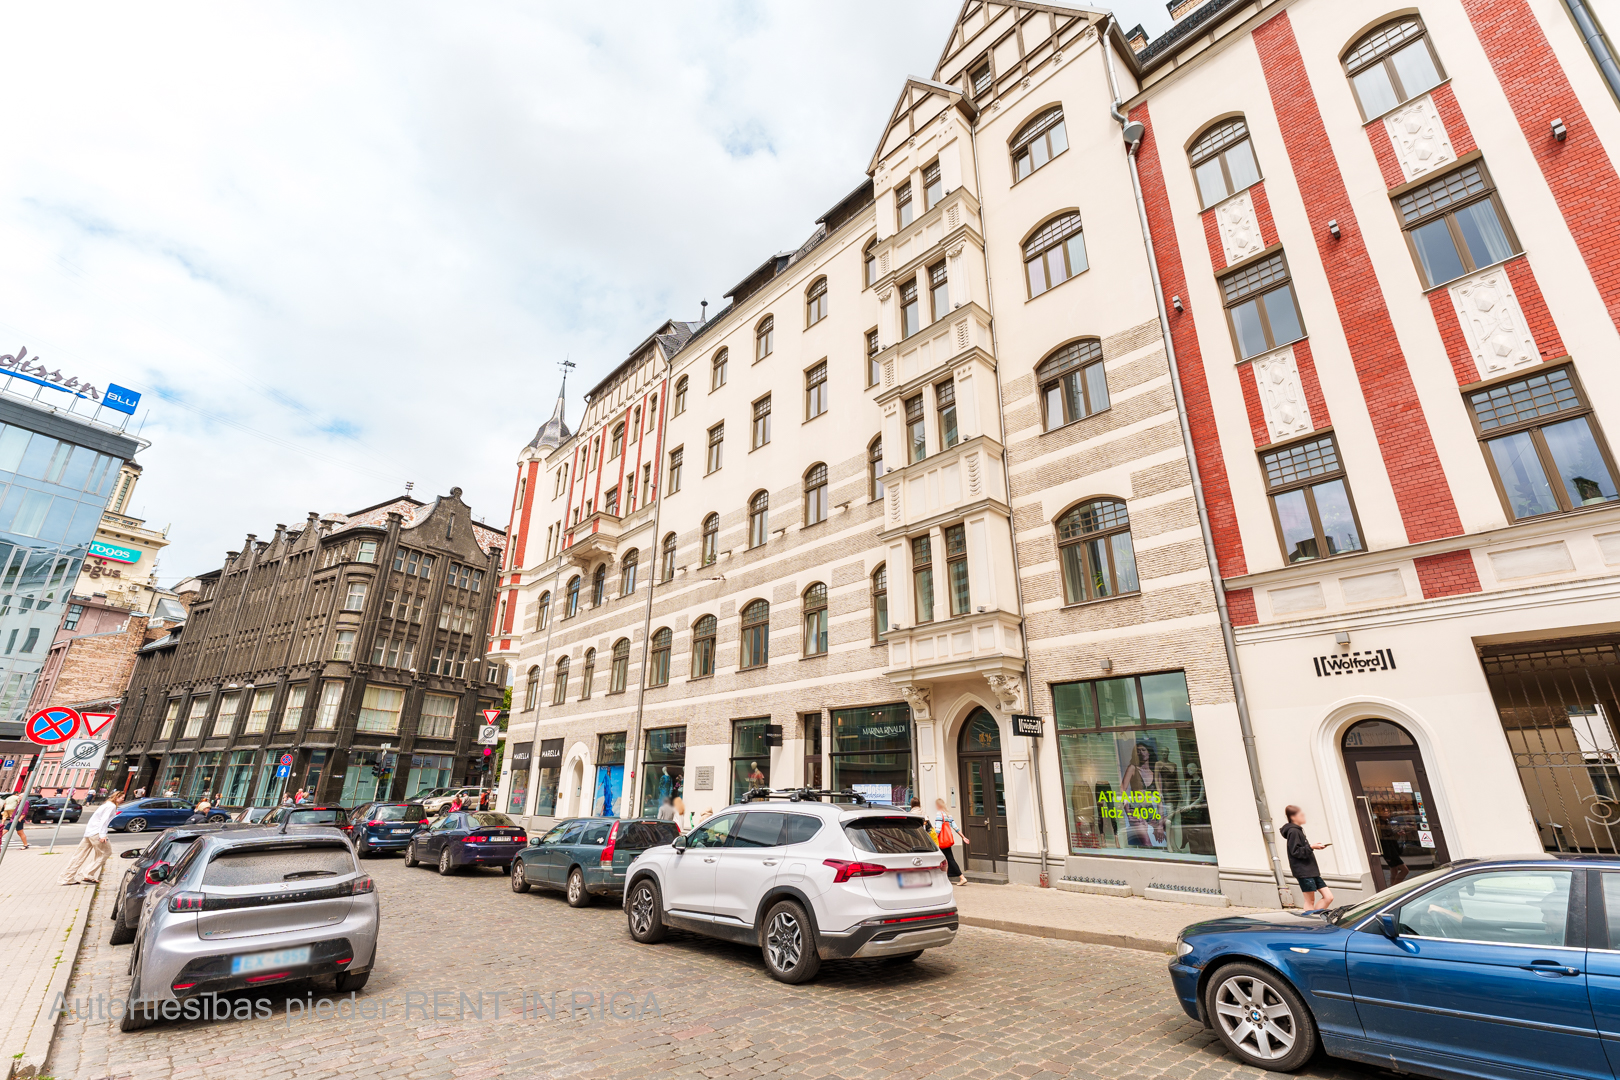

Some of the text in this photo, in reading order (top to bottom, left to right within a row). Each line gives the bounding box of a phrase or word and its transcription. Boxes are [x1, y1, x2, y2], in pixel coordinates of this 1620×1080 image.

[107, 392, 137, 407] BLU
[90, 543, 130, 558] rogas
[1327, 655, 1380, 671] Wolford
[862, 724, 906, 737] MARINA RINALDI
[513, 752, 530, 760] MARELLA
[541, 749, 560, 758] MARELLA
[1097, 790, 1162, 804] ATLAIDES
[1100, 806, 1162, 820] līdz -40%
